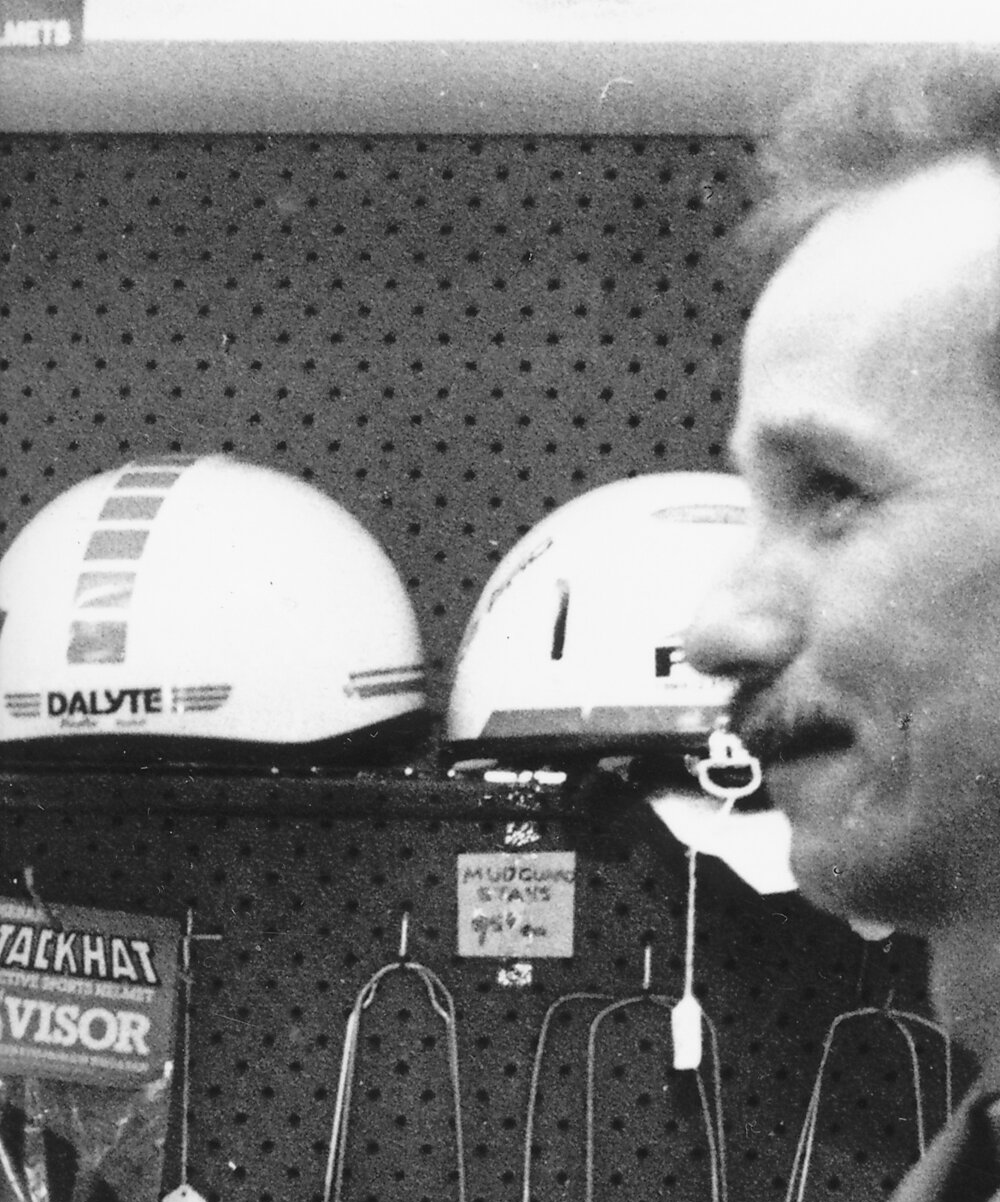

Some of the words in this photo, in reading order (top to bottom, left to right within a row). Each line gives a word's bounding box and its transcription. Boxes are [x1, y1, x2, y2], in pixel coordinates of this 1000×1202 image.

[0, 19, 71, 46] METS
[47, 687, 162, 716] DALYTE
[5, 996, 151, 1055] VISOR
